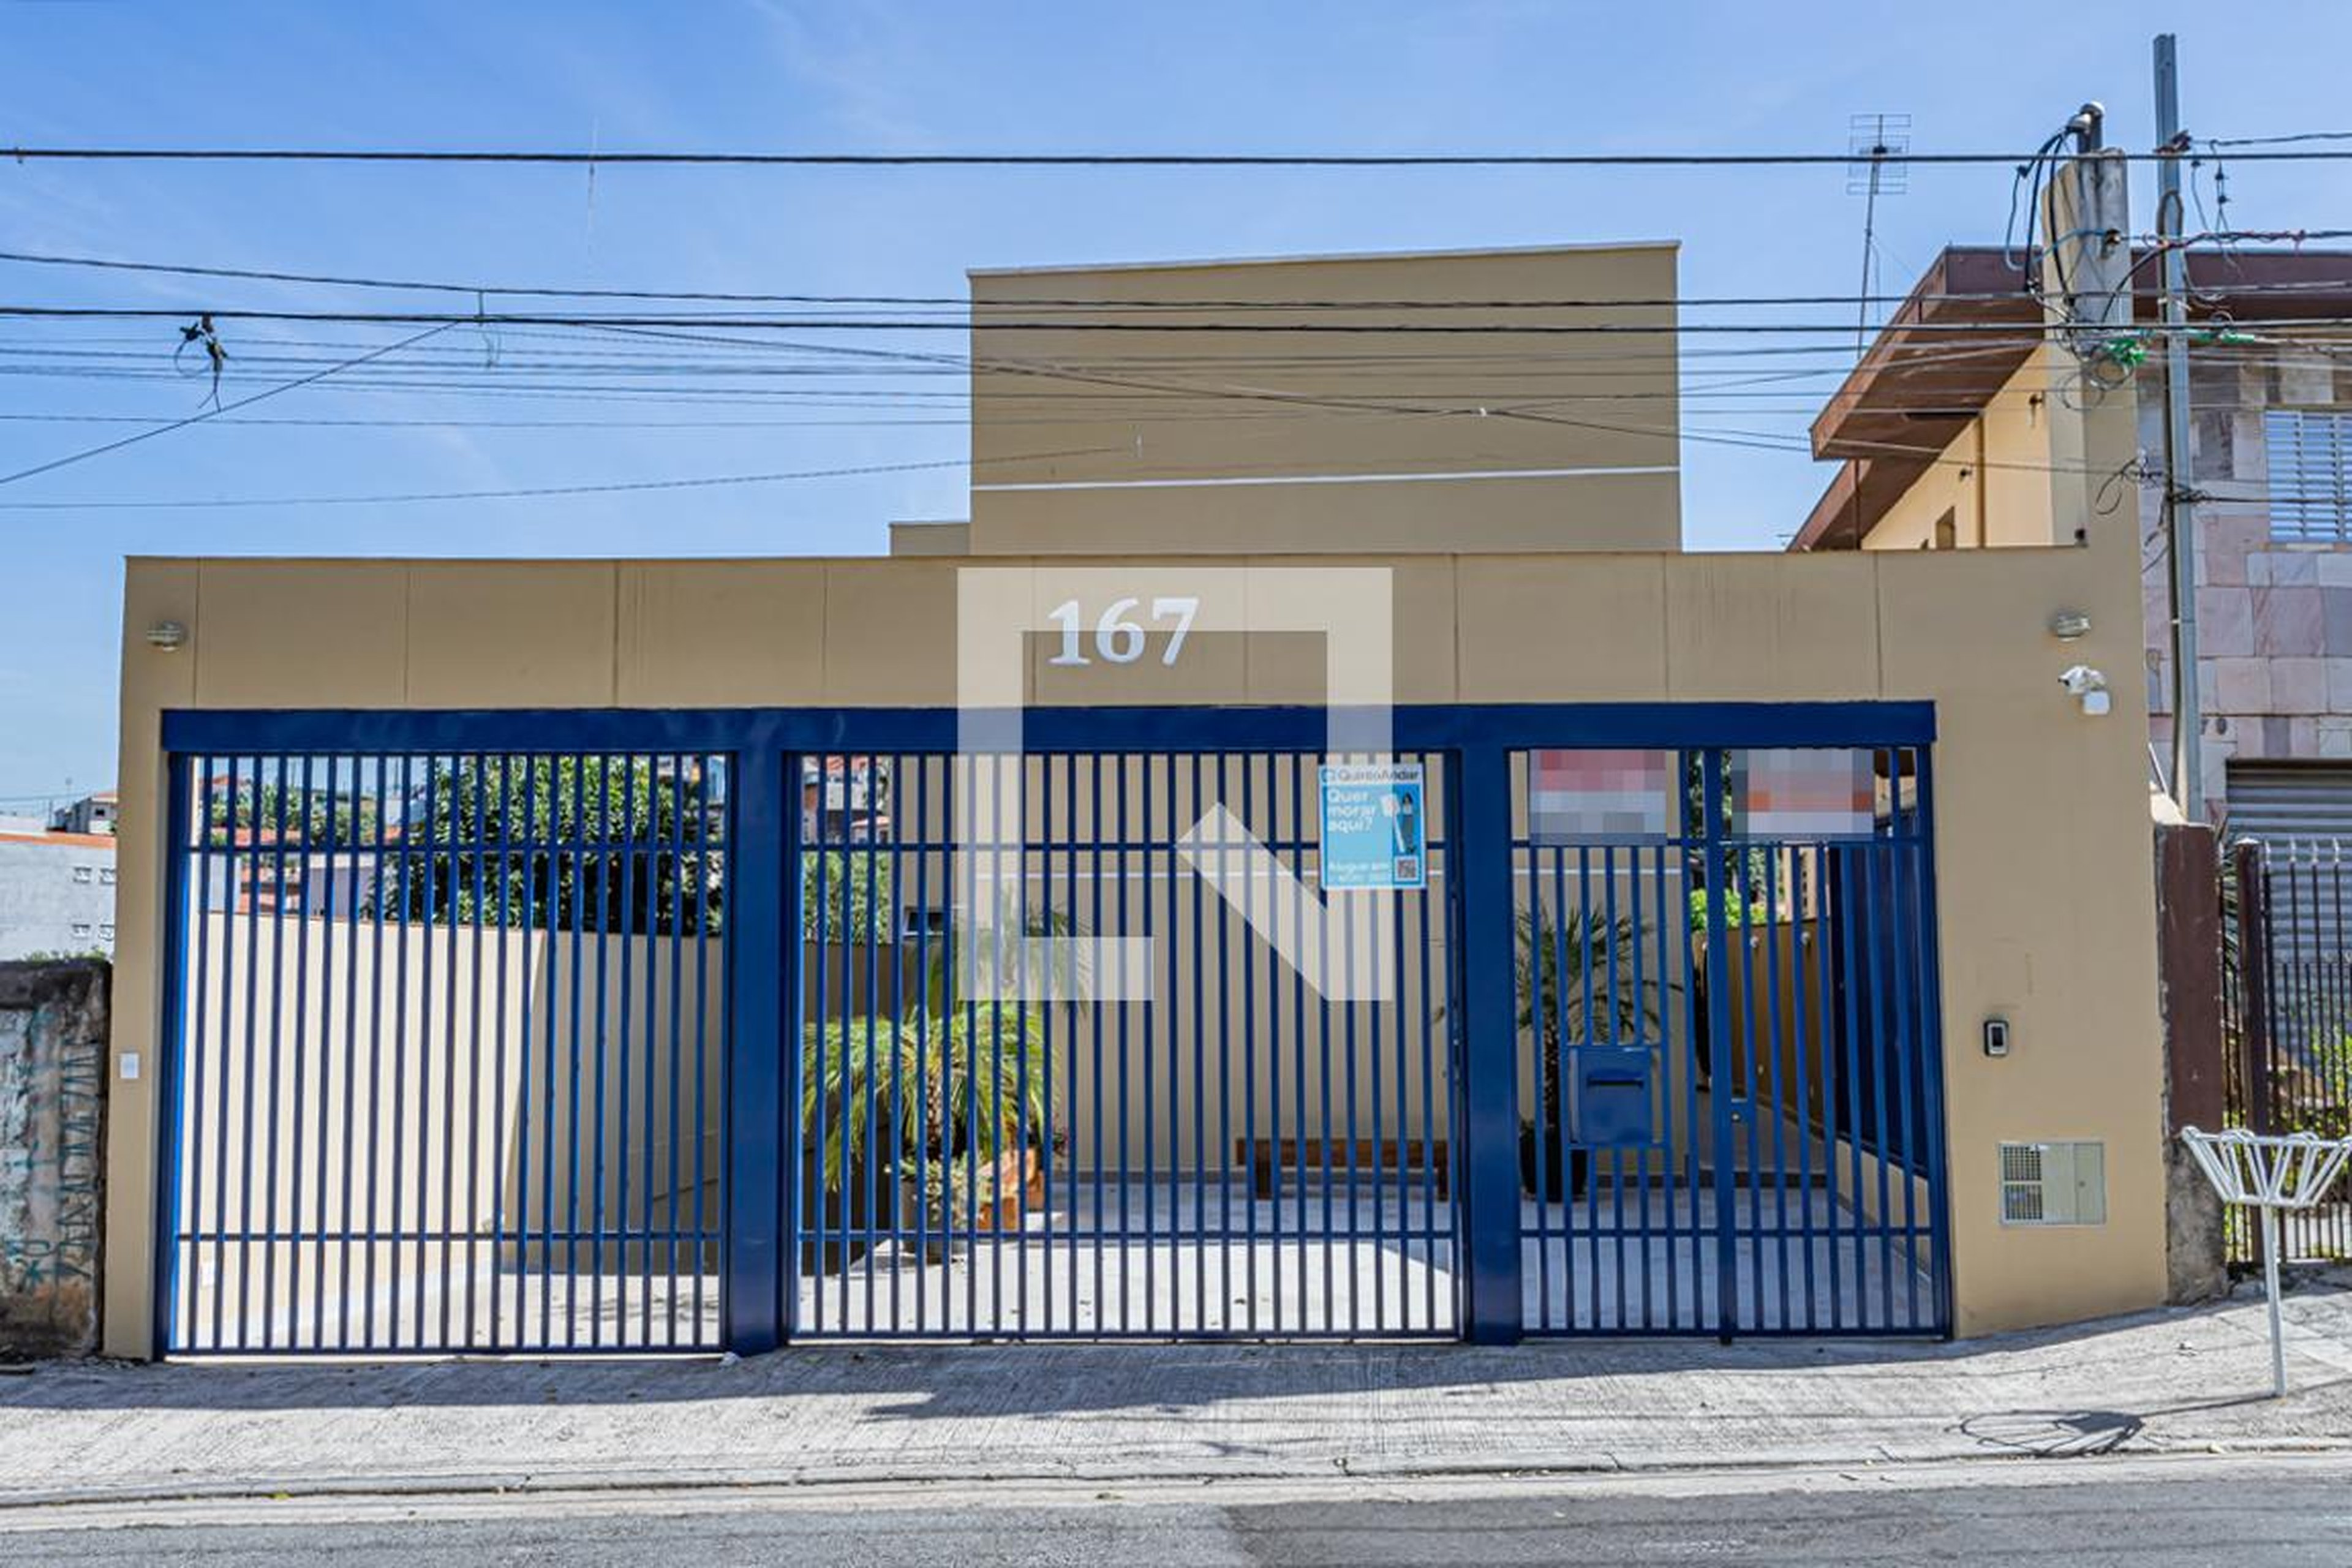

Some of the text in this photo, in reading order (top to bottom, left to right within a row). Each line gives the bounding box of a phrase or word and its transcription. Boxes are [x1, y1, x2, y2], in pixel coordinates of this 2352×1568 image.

[1047, 597, 1199, 665] 167
[1327, 789, 1370, 802] Quer
[1327, 805, 1375, 817] morar
[1327, 817, 1373, 833] aqui?
